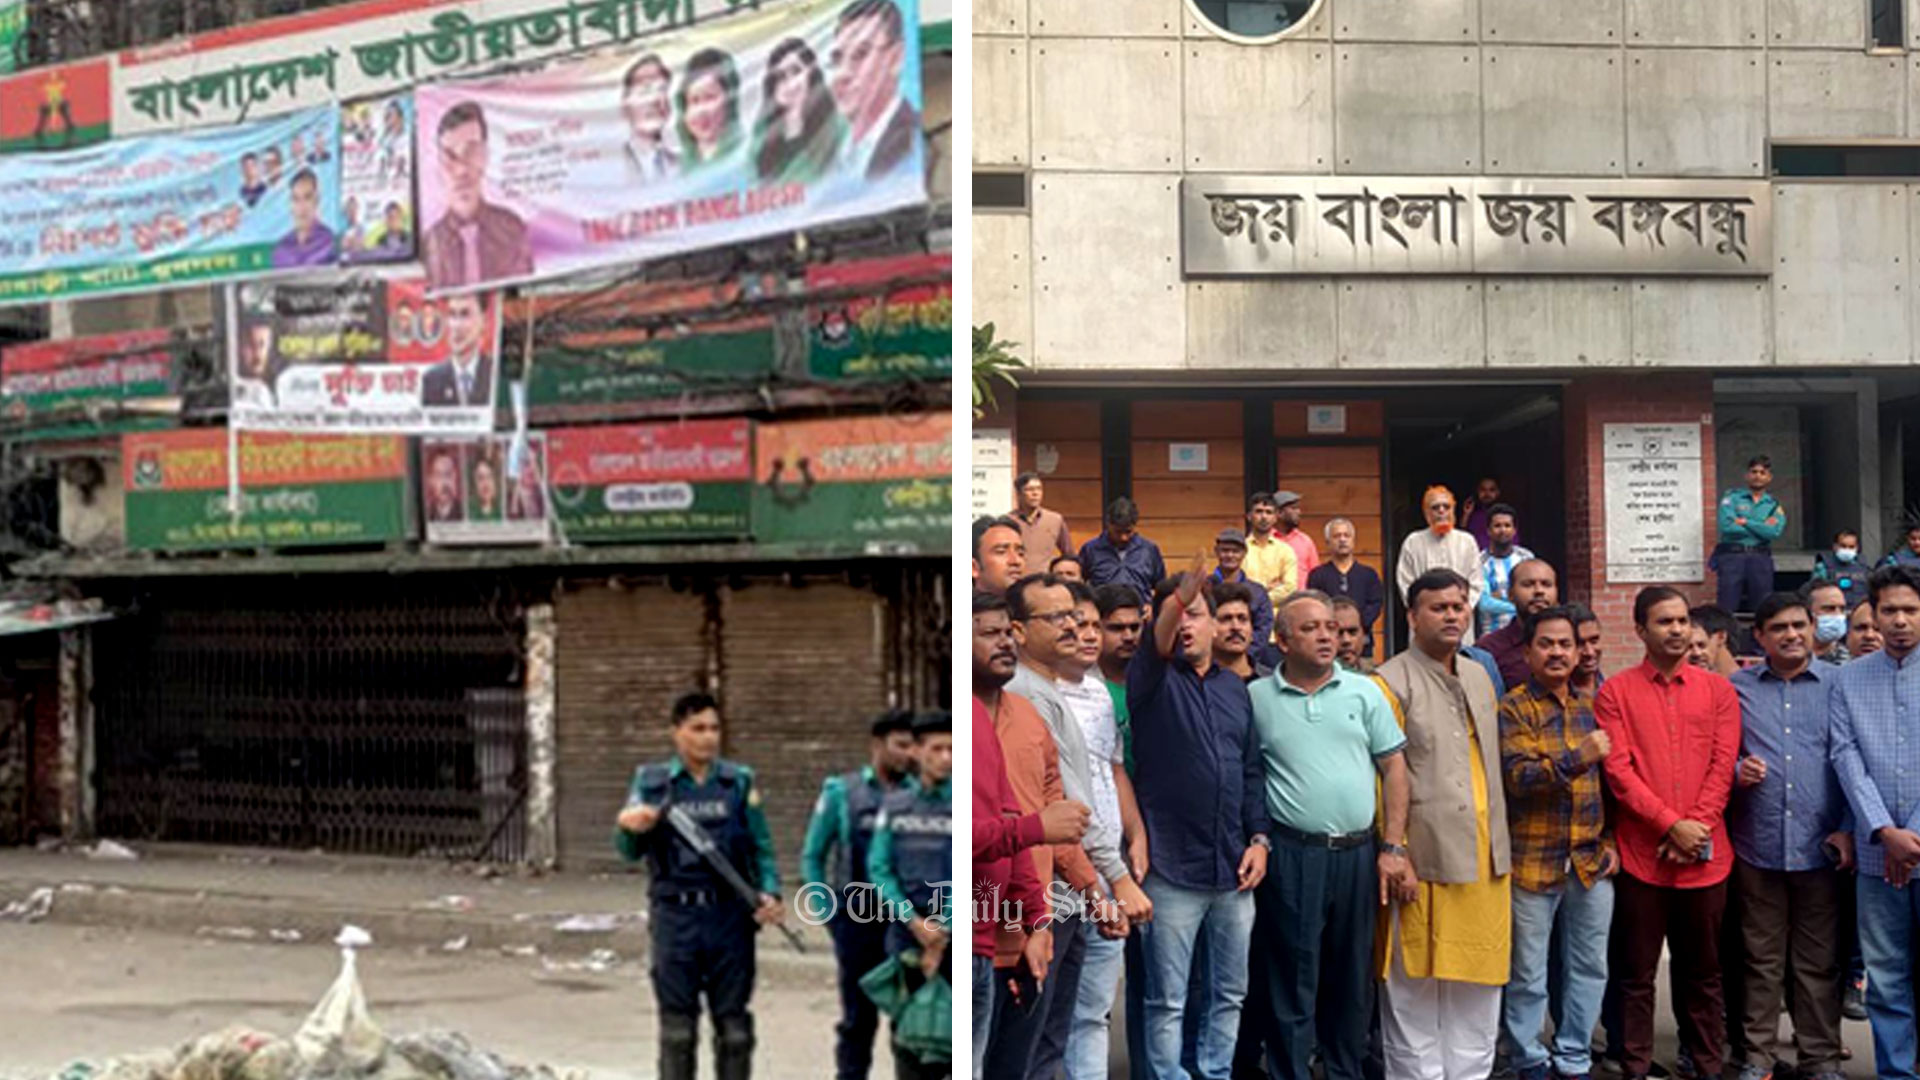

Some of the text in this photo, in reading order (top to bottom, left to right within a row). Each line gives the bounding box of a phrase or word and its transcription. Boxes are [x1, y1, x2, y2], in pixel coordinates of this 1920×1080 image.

[127, 47, 340, 122] বাংলাদেশ
[1203, 186, 1754, 262] জয় বাংলা জয় বঙ্গবন্ধু
